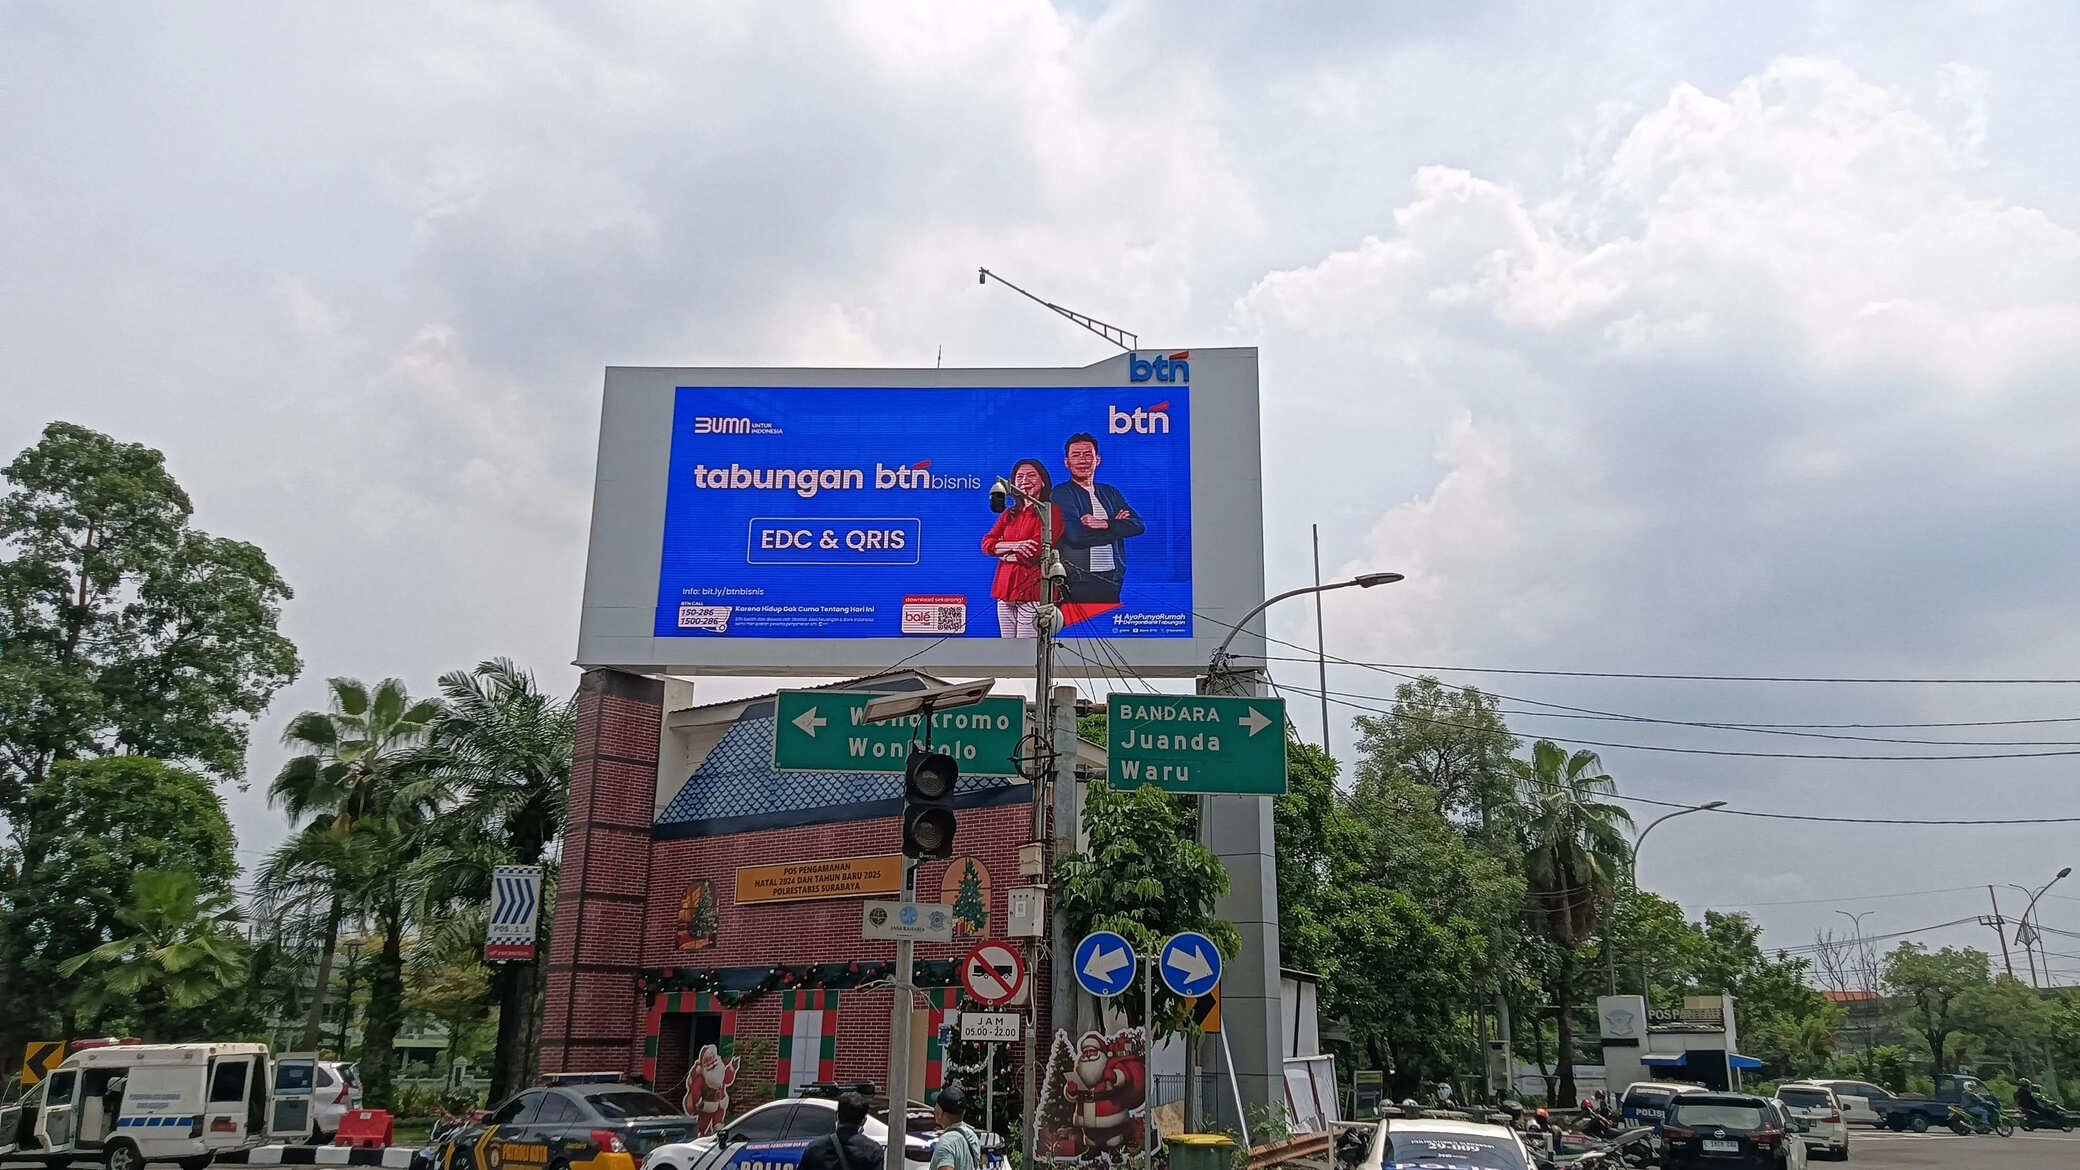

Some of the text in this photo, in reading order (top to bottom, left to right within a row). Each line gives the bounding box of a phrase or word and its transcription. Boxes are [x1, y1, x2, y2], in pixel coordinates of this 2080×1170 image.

[1130, 351, 1190, 382] btn
[695, 417, 750, 434] BUMN
[1109, 401, 1170, 434] btn
[694, 463, 863, 498] tabungan
[931, 474, 981, 490] bisnis
[761, 529, 905, 552] EDC & QRIS
[682, 587, 764, 597] Info: bit.ly/btnbisnis
[820, 606, 850, 614] Tentang
[1120, 705, 1220, 722] BANDARA
[1121, 730, 1220, 751] Juanda
[1121, 760, 1189, 781] Waru
[784, 863, 851, 875] POS PENGAMANAN
[754, 879, 777, 888] NATAL
[797, 876, 813, 885] DAN
[815, 874, 840, 883] TAHUN
[842, 872, 862, 880] BARU
[864, 870, 881, 878] 2025
[773, 882, 860, 896] POLRESTABES SURABAYA
[977, 1017, 1004, 1026] JAM
[965, 1028, 988, 1036] 05.00
[994, 1028, 1016, 1037] 22.00
[1635, 1108, 1666, 1119] POLISI
